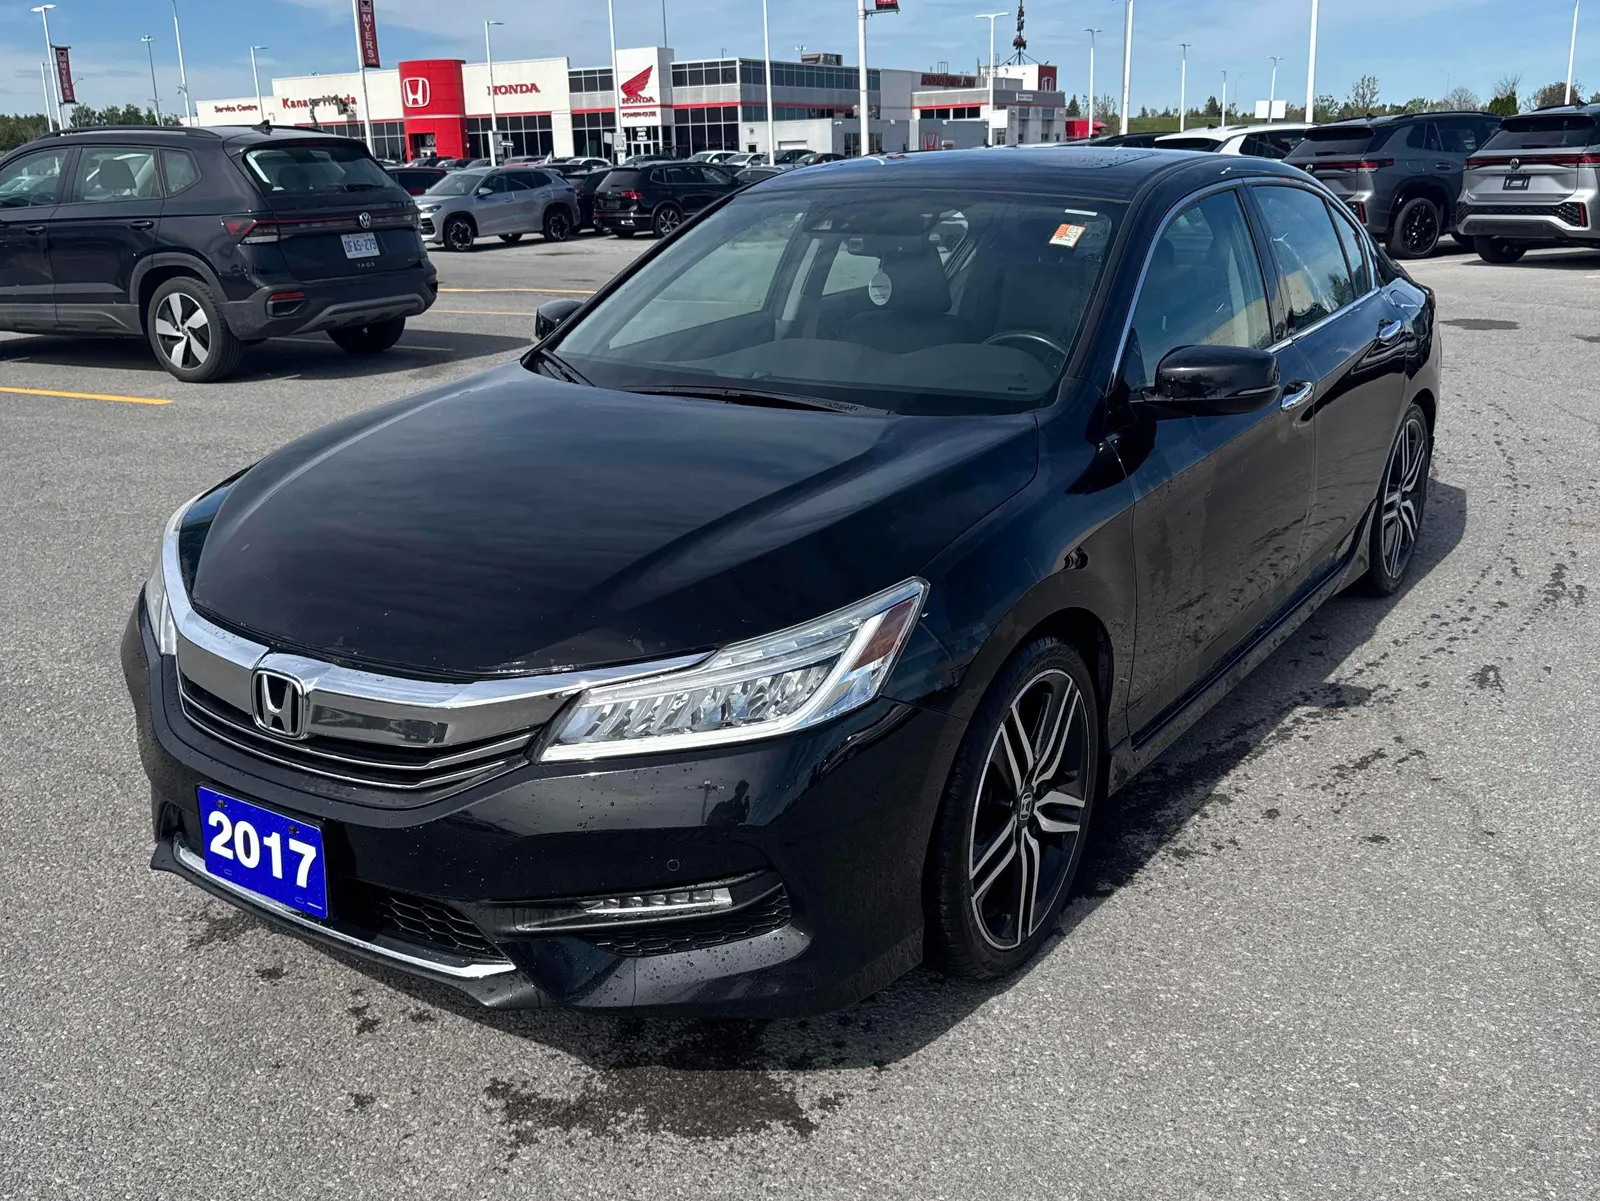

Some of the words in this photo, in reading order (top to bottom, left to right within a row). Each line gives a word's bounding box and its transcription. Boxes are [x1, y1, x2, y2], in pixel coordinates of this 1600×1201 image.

[362, 14, 375, 58] MYERS
[59, 62, 71, 96] MYERS
[486, 82, 541, 97] HONDA
[621, 96, 656, 106] HONDA
[214, 104, 236, 114] Service
[237, 104, 258, 112] Centre
[356, 261, 376, 269] TAOS
[208, 810, 317, 889] 2017
